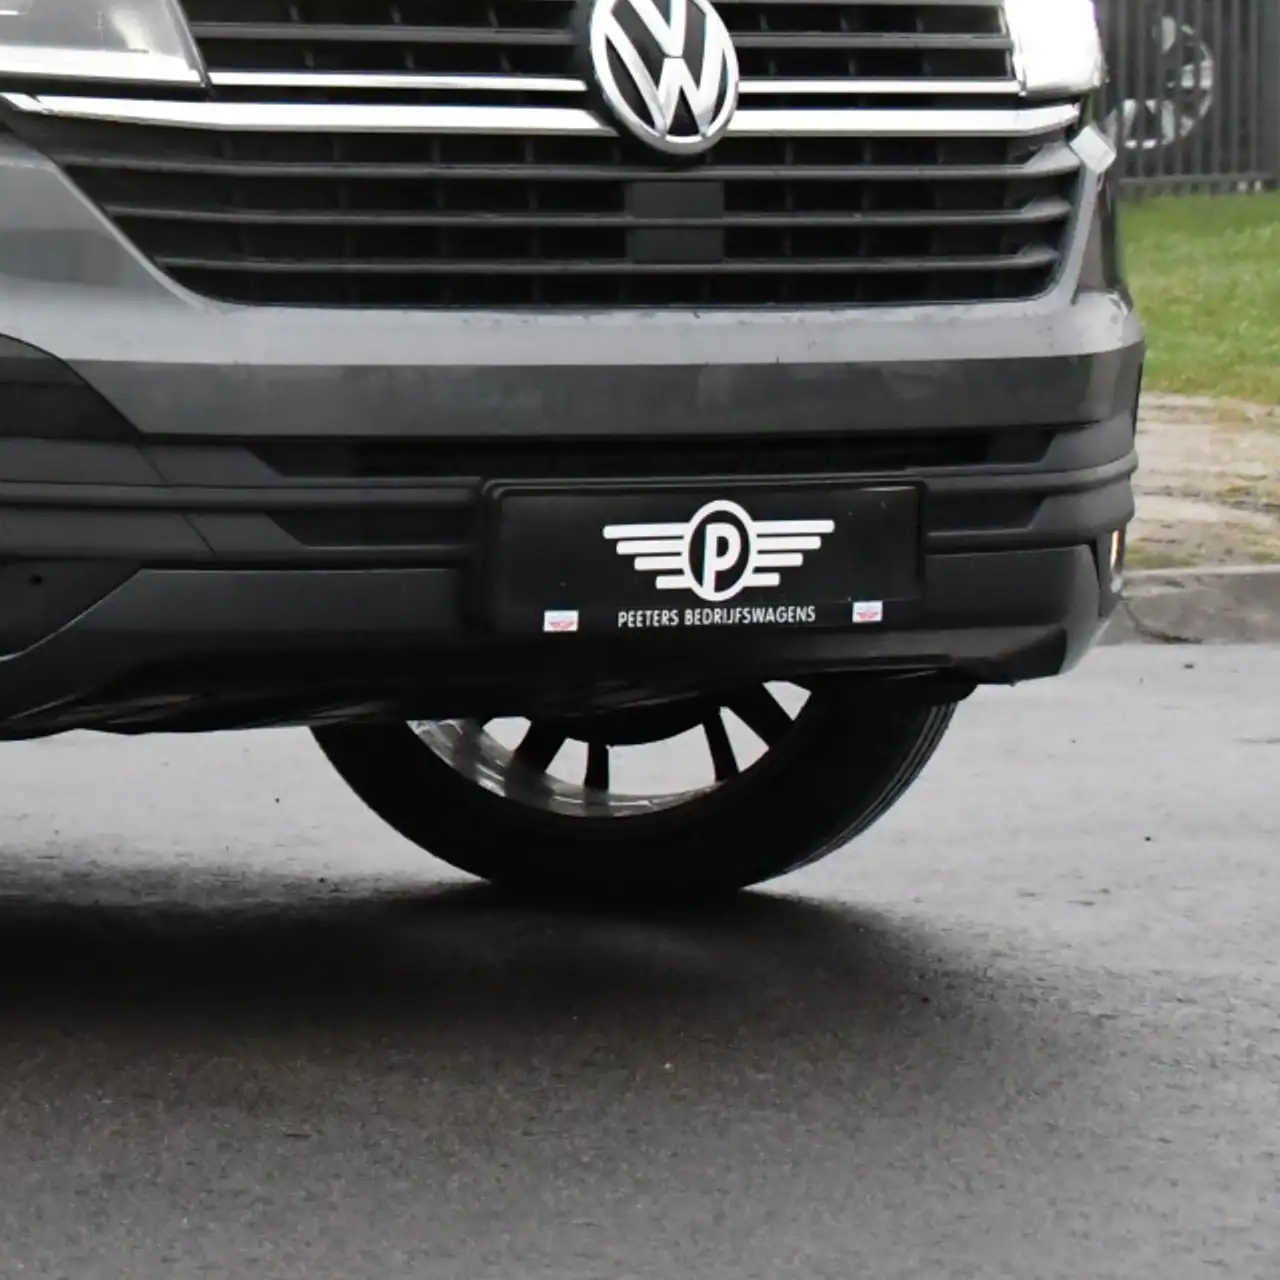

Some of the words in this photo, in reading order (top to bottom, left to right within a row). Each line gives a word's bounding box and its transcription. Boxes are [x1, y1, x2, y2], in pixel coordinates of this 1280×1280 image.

[702, 522, 741, 595] P
[617, 609, 680, 628] PEETERS
[684, 605, 816, 626] BEDRIJFSWAGENS
